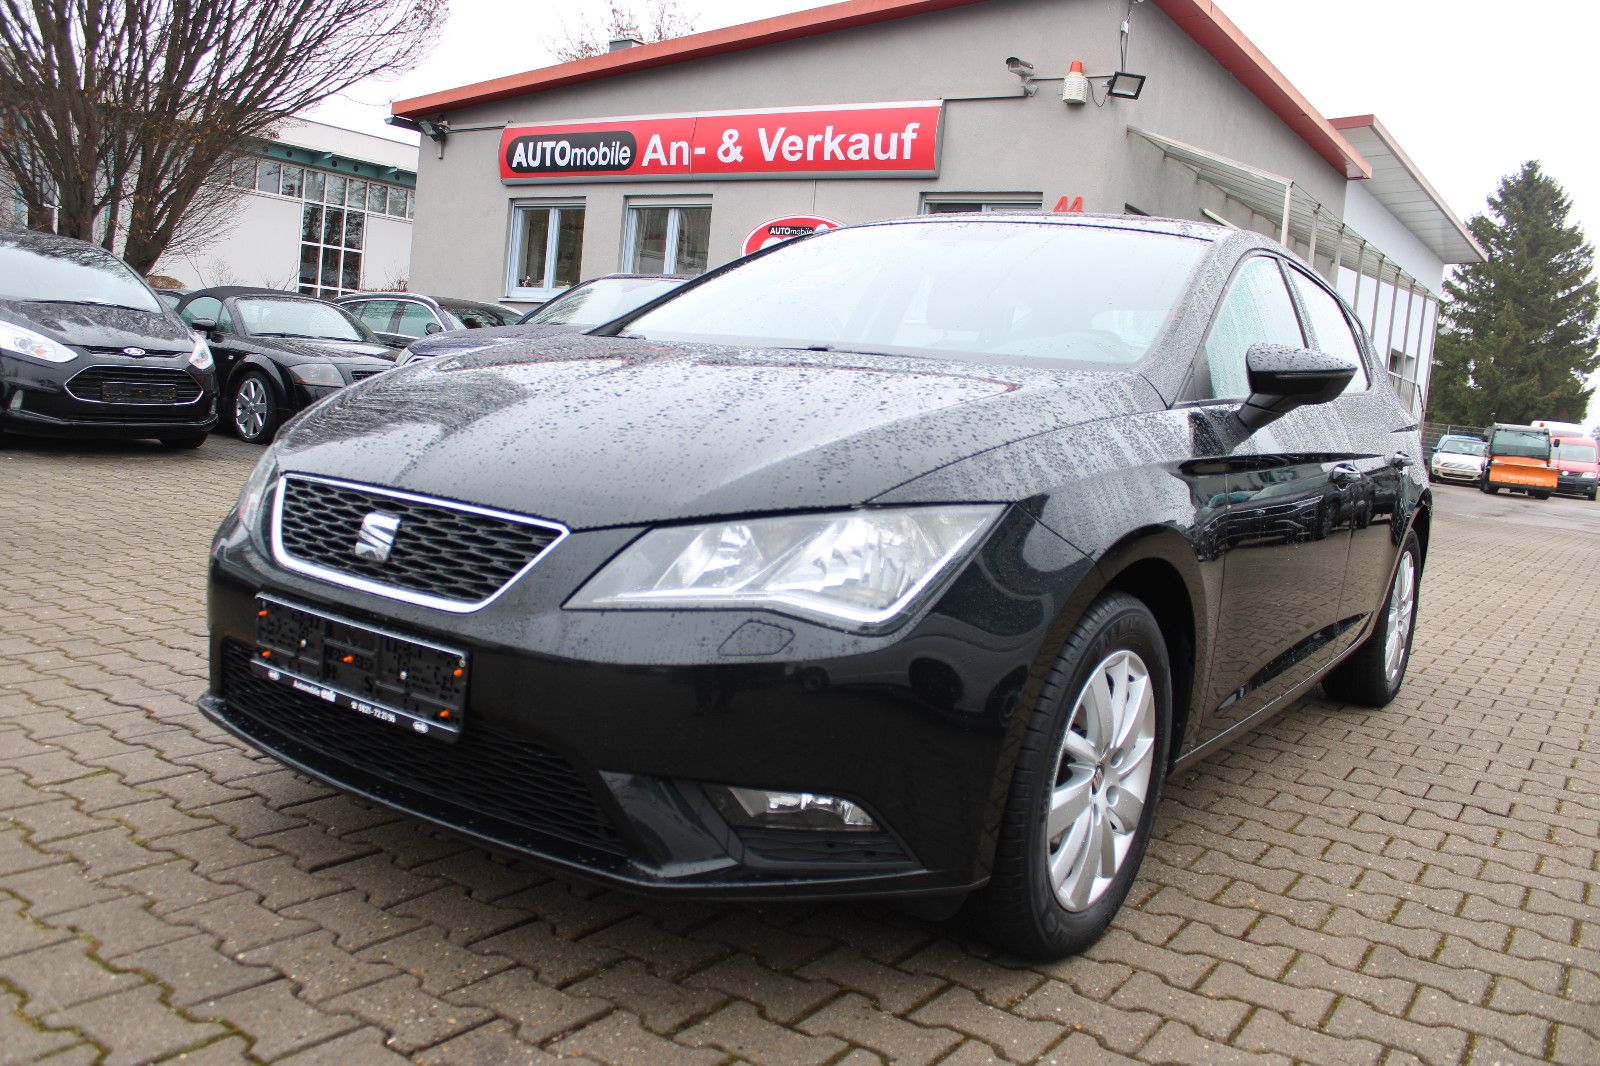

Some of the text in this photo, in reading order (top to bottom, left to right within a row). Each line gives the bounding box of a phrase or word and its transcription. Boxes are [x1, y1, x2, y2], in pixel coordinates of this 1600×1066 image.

[511, 122, 921, 168] AUTOmobile An- & Verkauf
